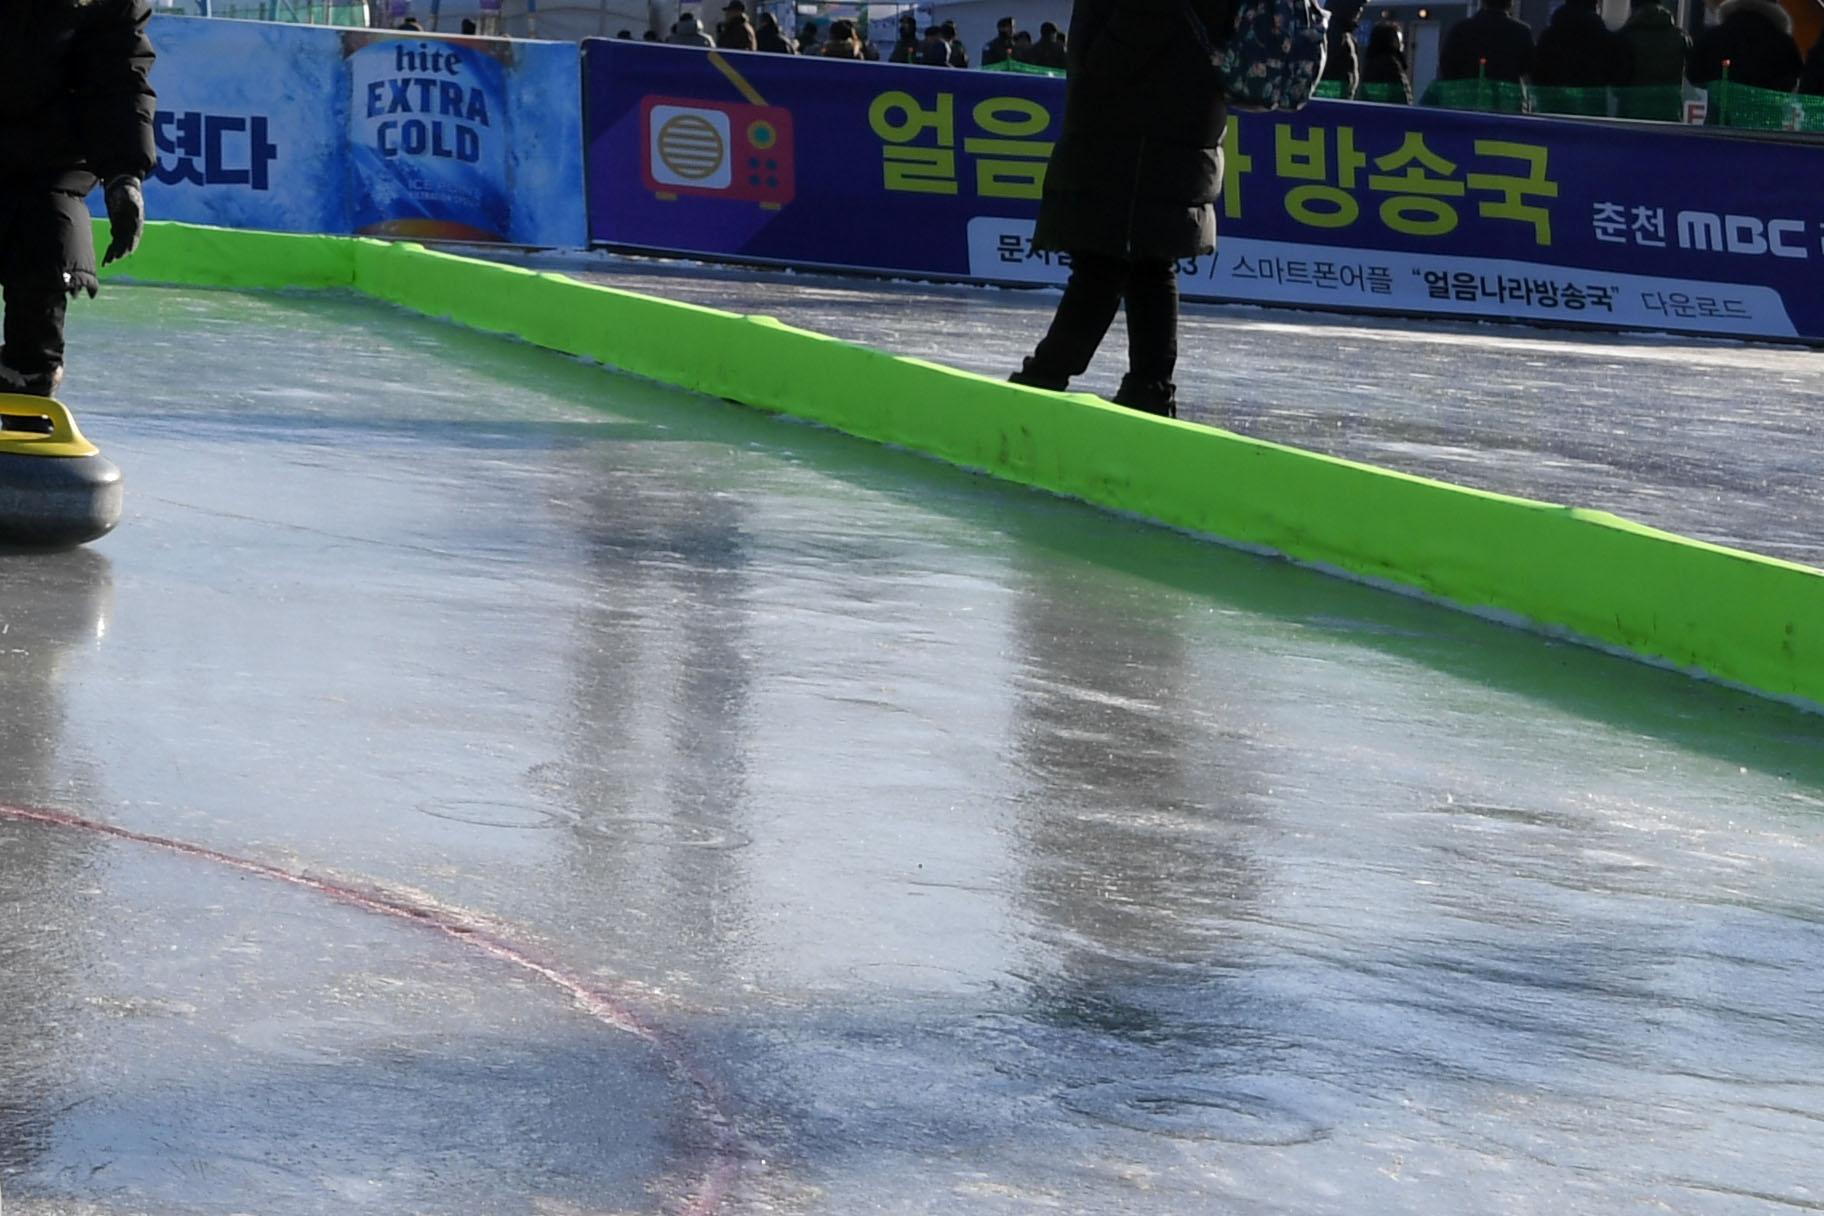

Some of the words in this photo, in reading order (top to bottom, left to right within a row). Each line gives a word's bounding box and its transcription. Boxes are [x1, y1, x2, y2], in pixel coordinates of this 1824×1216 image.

[395, 42, 462, 77] hite
[367, 77, 490, 129] EXTRA
[376, 118, 480, 164] COLD
[1276, 122, 1559, 247] 방송국
[1592, 202, 1666, 248] 춘천
[1677, 210, 1808, 259] MBC
[1231, 255, 1394, 296] 스마트폰어플
[1641, 291, 1753, 320] 다운로드
